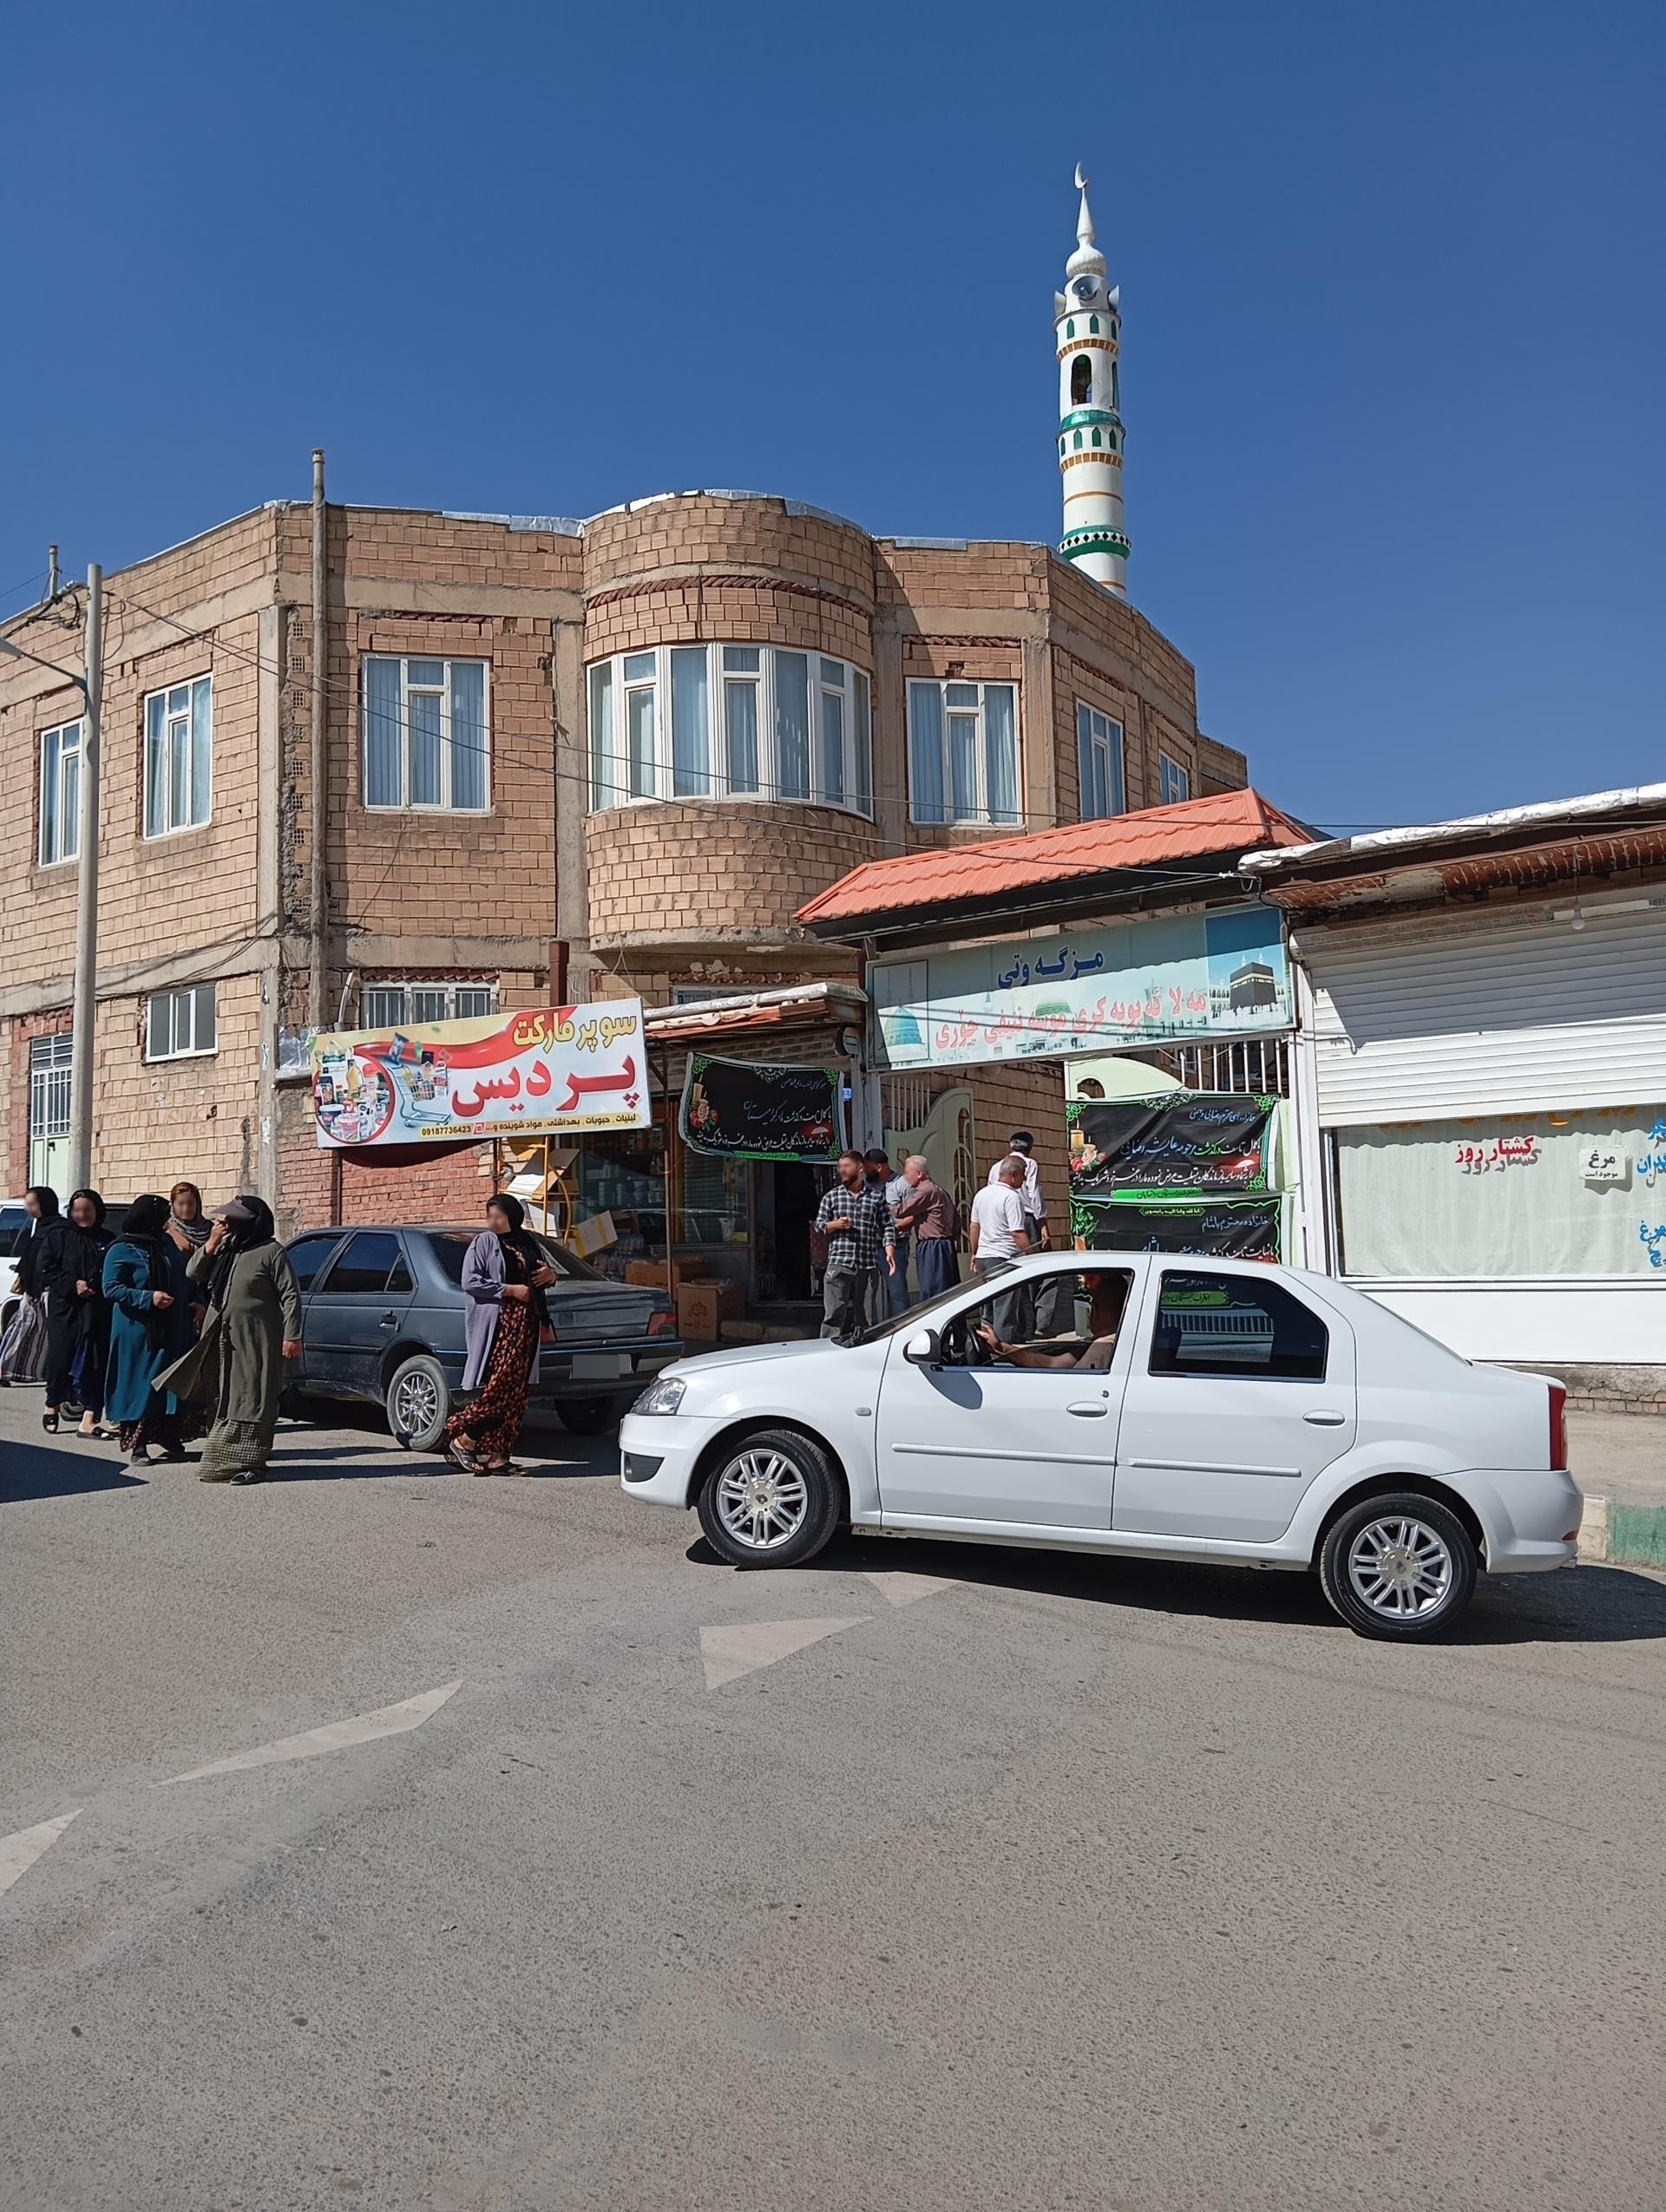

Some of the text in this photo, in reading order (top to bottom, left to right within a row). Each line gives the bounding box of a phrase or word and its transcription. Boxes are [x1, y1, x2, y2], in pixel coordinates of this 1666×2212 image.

[512, 1011, 575, 1054] مارکت
[451, 1054, 640, 1117] پردیس
[422, 1125, 472, 1136] 09187736423
[1454, 1136, 1535, 1163] کشتار روز
[1588, 1149, 1616, 1168] مرغ
